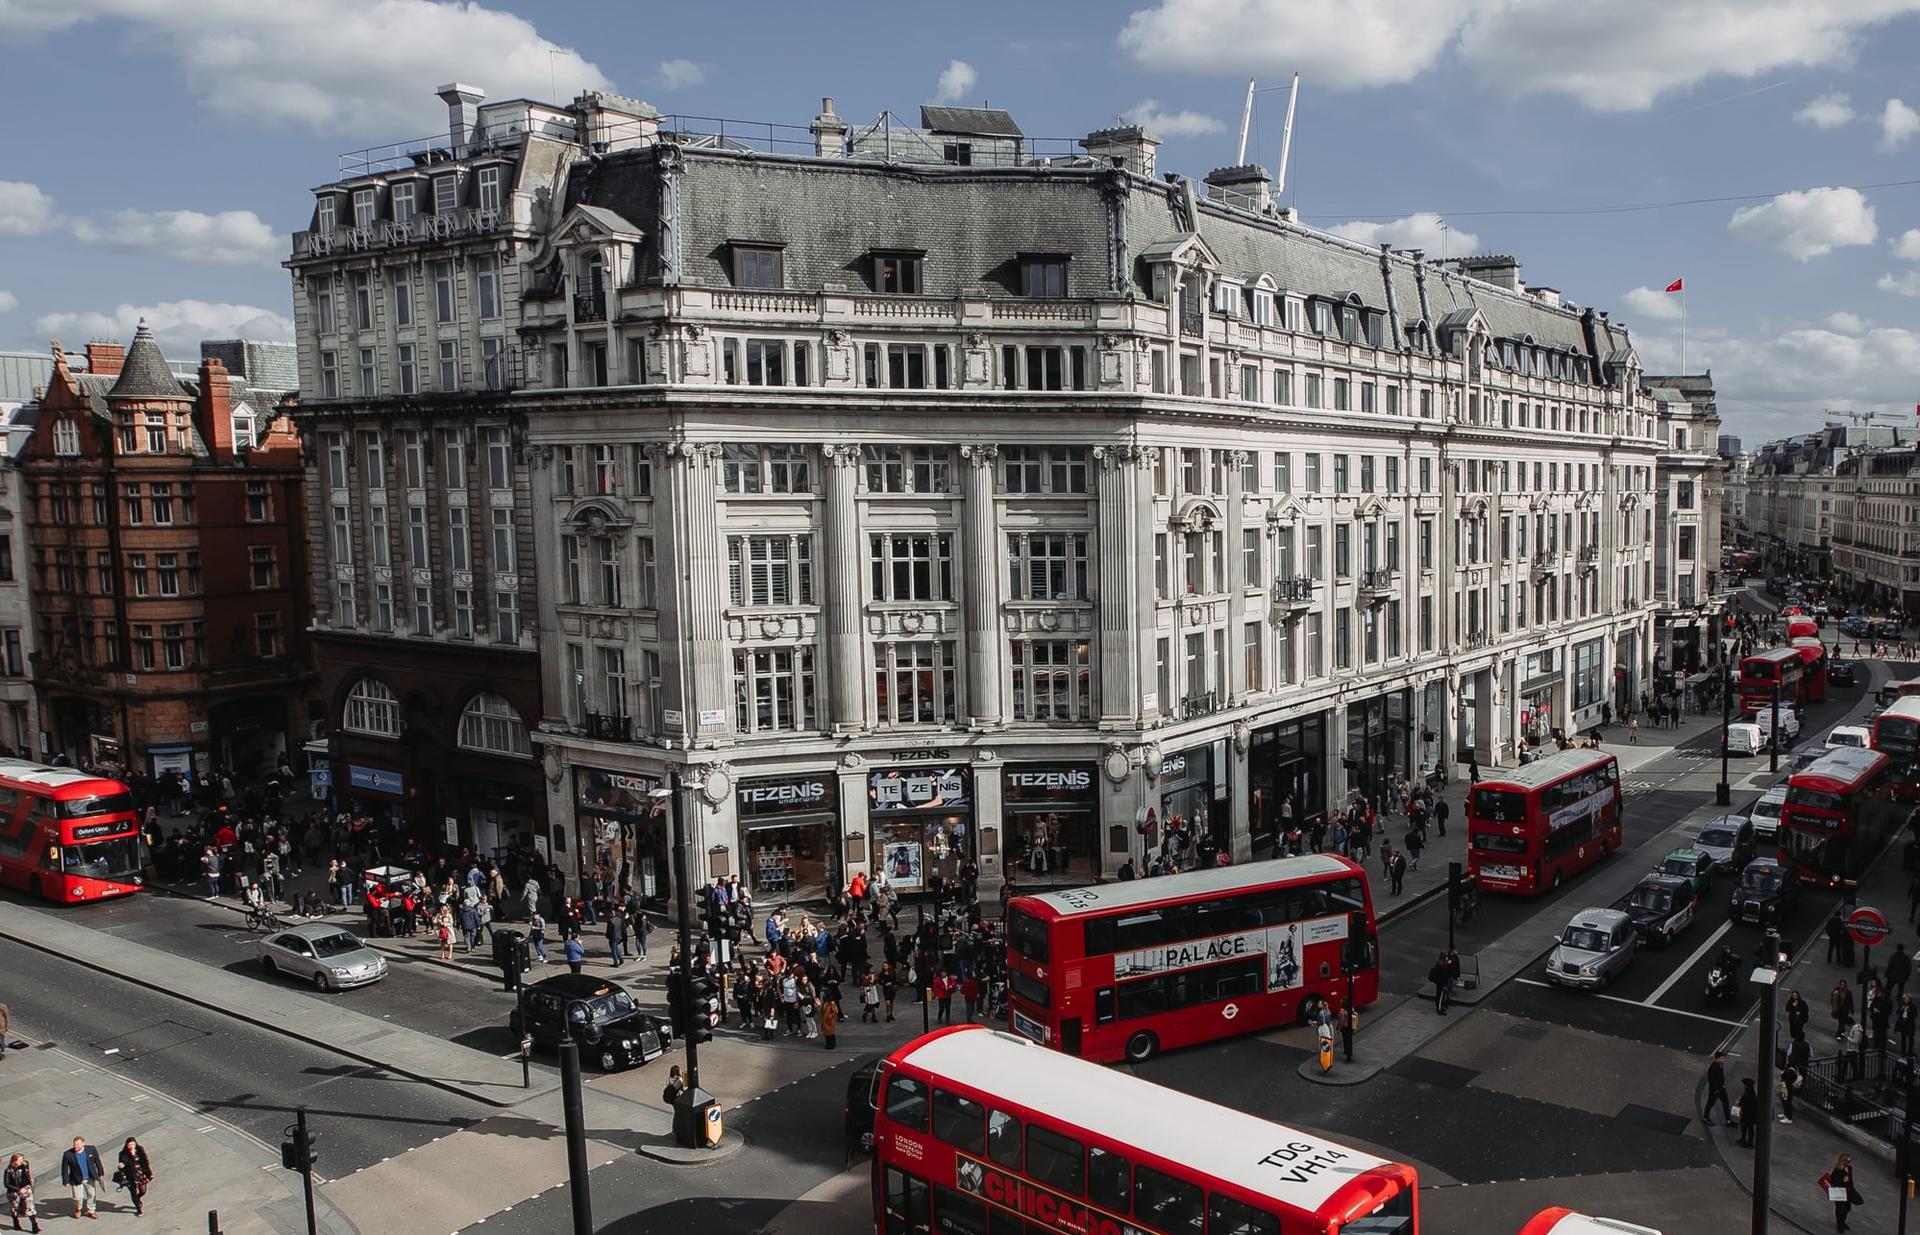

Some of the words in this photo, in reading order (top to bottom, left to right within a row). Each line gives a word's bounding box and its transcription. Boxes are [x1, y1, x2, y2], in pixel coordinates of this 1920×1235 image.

[889, 747, 951, 761] TEZENIS
[1160, 756, 1186, 775] ENIS
[1007, 769, 1091, 787] TEZENIS
[738, 781, 825, 803] TEZENIS
[881, 785, 898, 794] TE
[911, 783, 928, 793] ZE
[1494, 811, 1505, 821] 25
[1166, 937, 1246, 967] PALACE
[895, 1134, 923, 1150] LONDON
[1257, 1142, 1316, 1167] TDG
[1280, 1150, 1349, 1183] VH14
